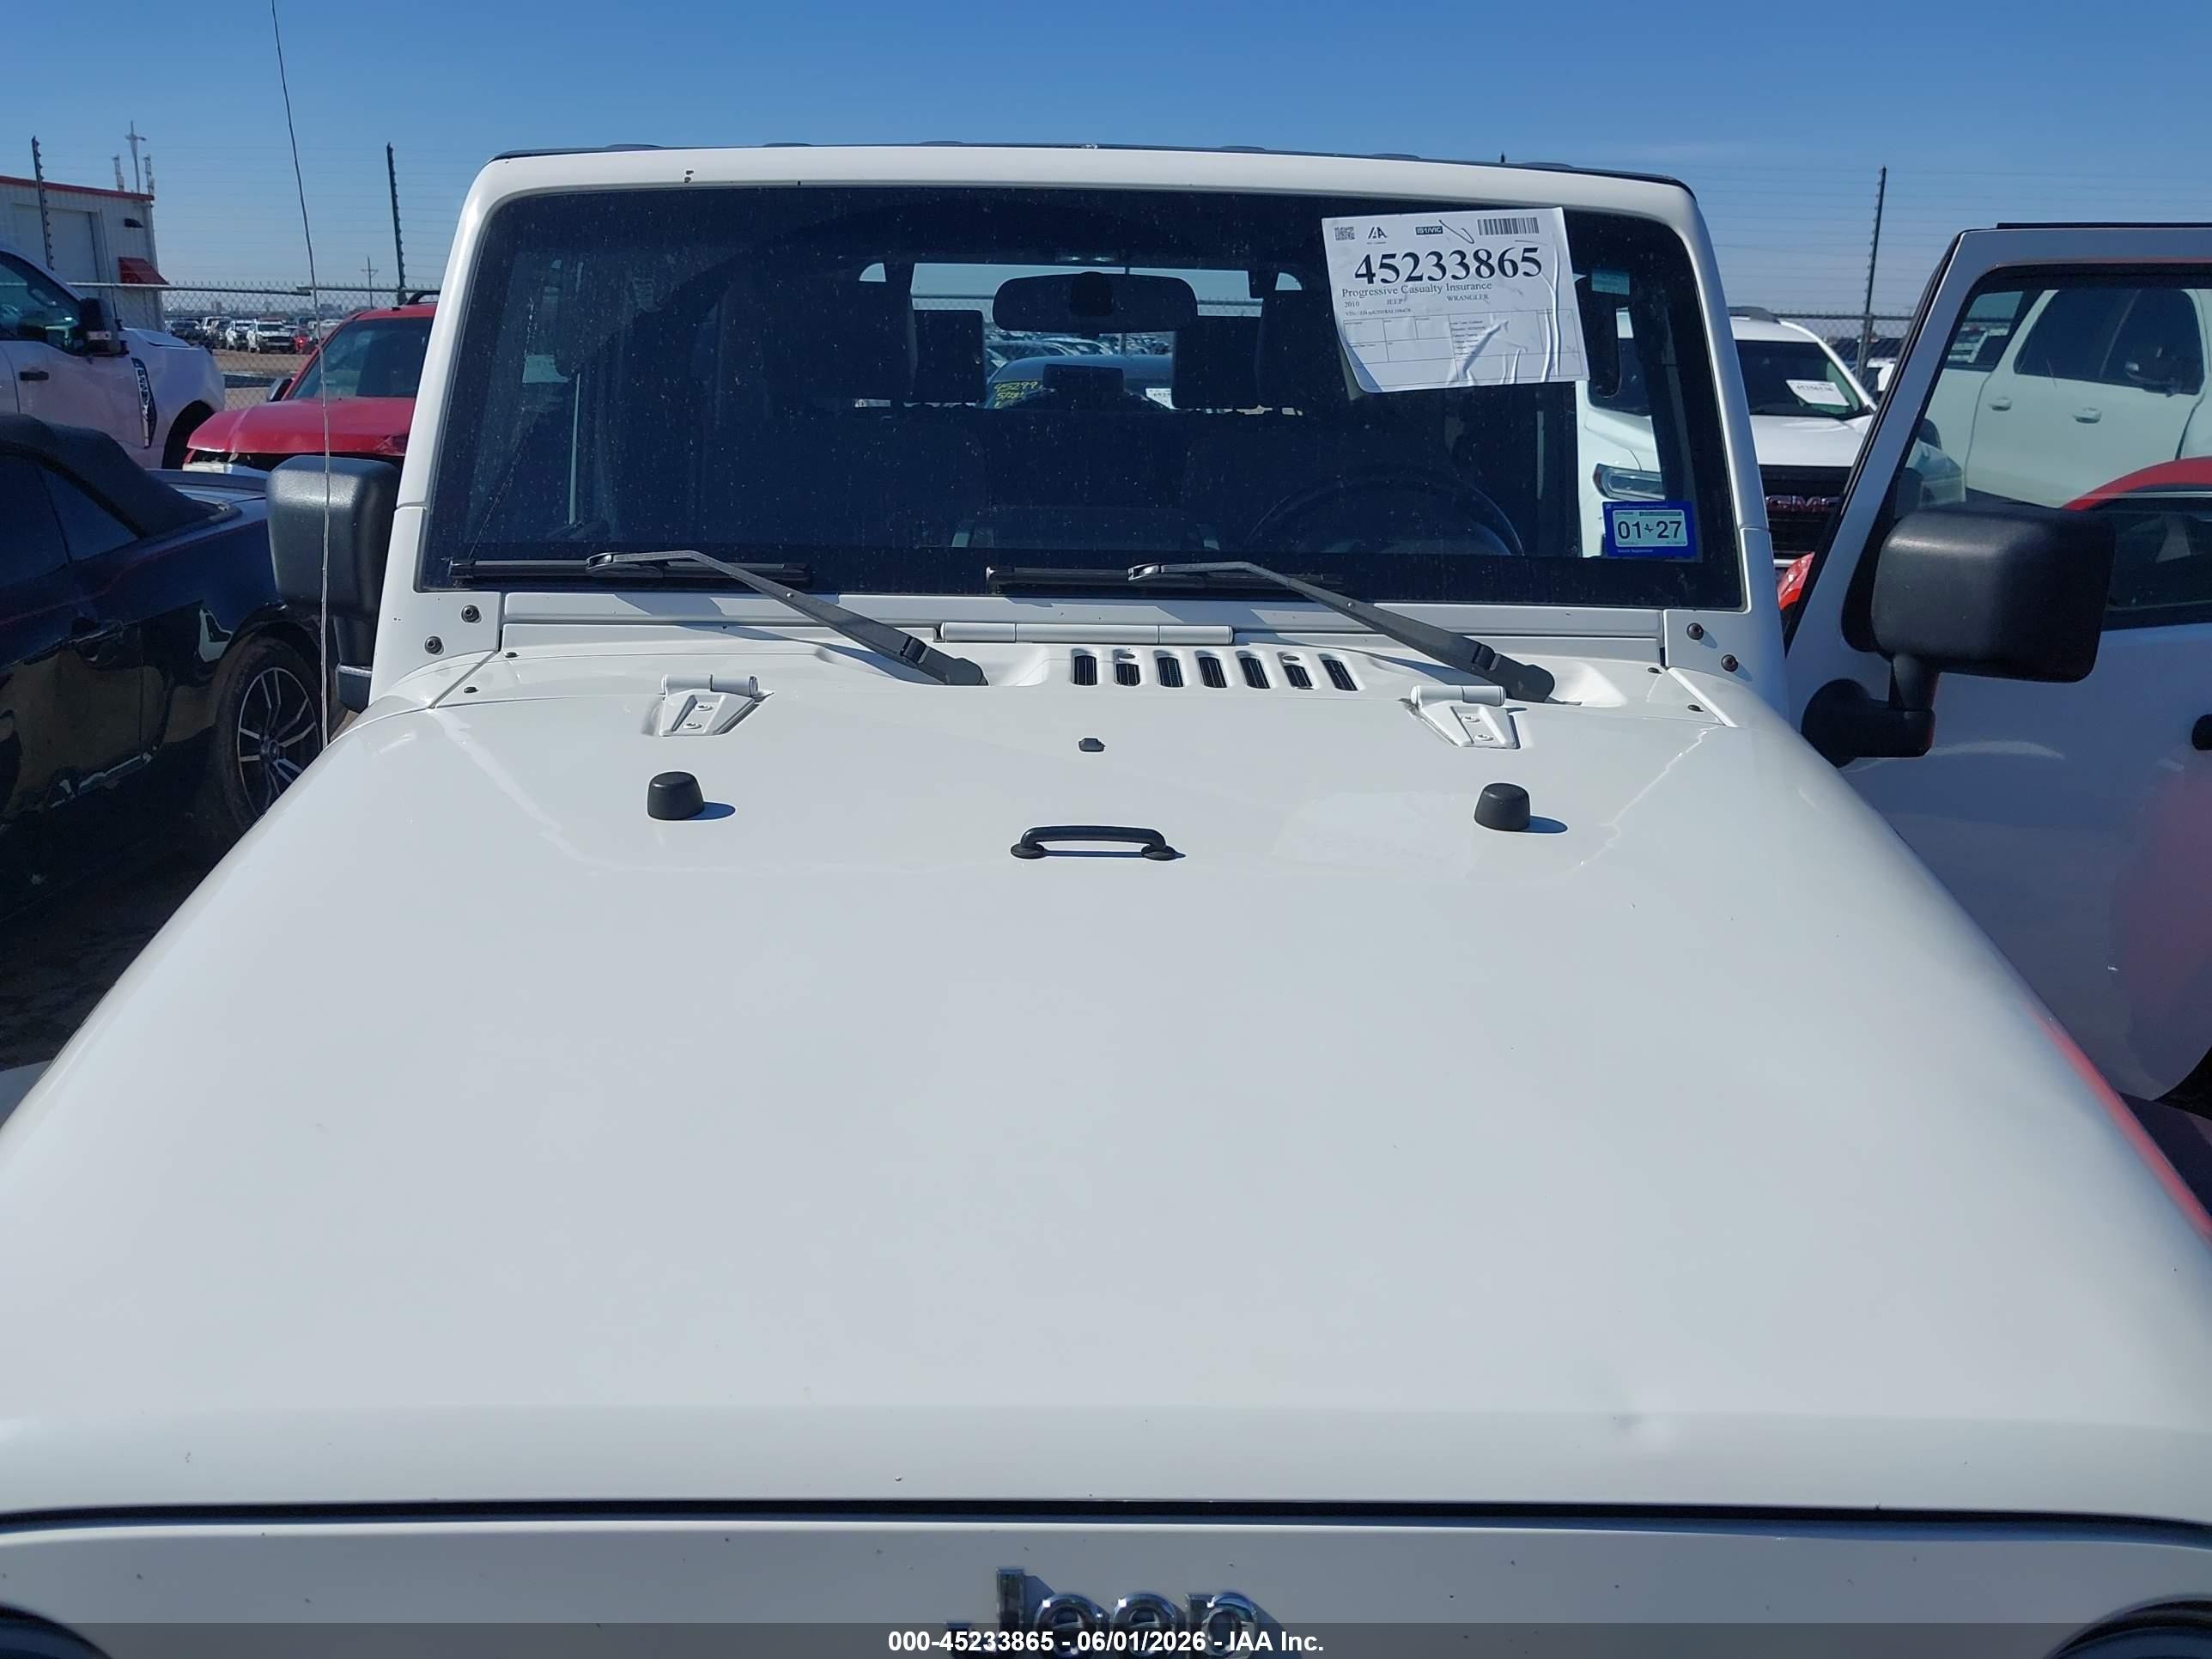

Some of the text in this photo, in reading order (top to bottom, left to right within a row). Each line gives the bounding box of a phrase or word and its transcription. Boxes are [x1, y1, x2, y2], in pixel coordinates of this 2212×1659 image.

[1354, 246, 1542, 285] 45233865
[1341, 282, 1492, 299] Progressive Casualty Insurance
[1617, 520, 1682, 539] 01 27
